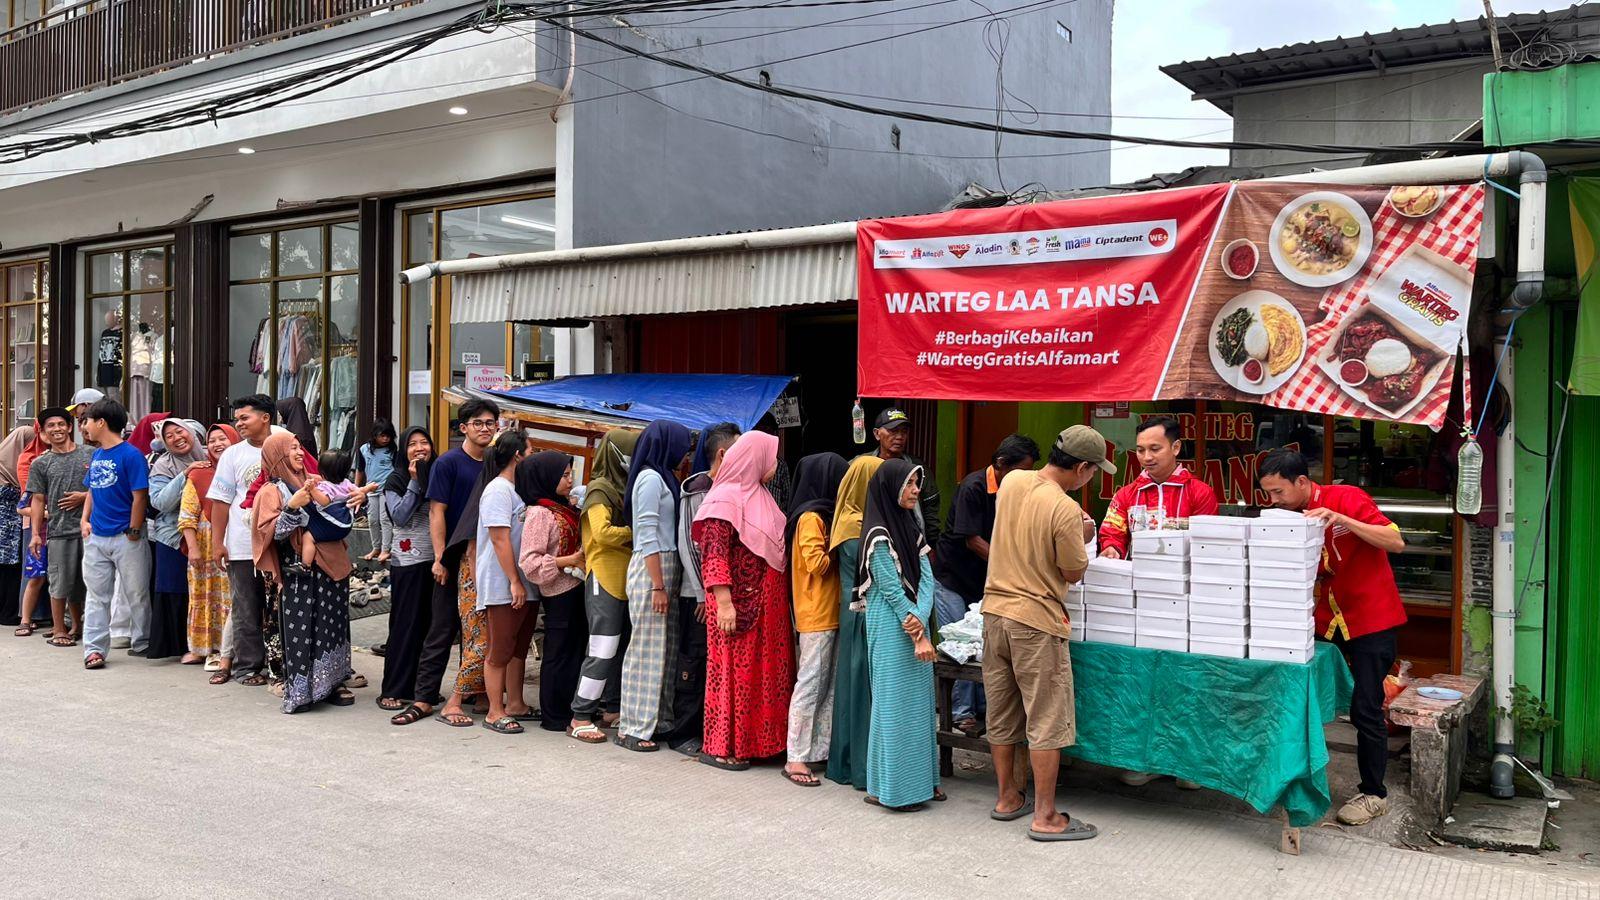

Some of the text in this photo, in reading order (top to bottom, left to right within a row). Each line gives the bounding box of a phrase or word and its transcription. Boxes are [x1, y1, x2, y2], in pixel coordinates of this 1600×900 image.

[947, 243, 971, 251] WINGS
[1045, 240, 1061, 248] Fresh
[1065, 237, 1091, 250] mama
[1095, 234, 1144, 246] Ciptadent
[975, 243, 1003, 255] Aladin
[885, 281, 1160, 314] WARTEG LAA TANSA
[1400, 278, 1460, 321] WARTEG
[1398, 291, 1447, 327] GRATIS
[935, 327, 1094, 348] #BerbagiKebaikan
[916, 349, 1120, 370] #WartegGratisAlfamart
